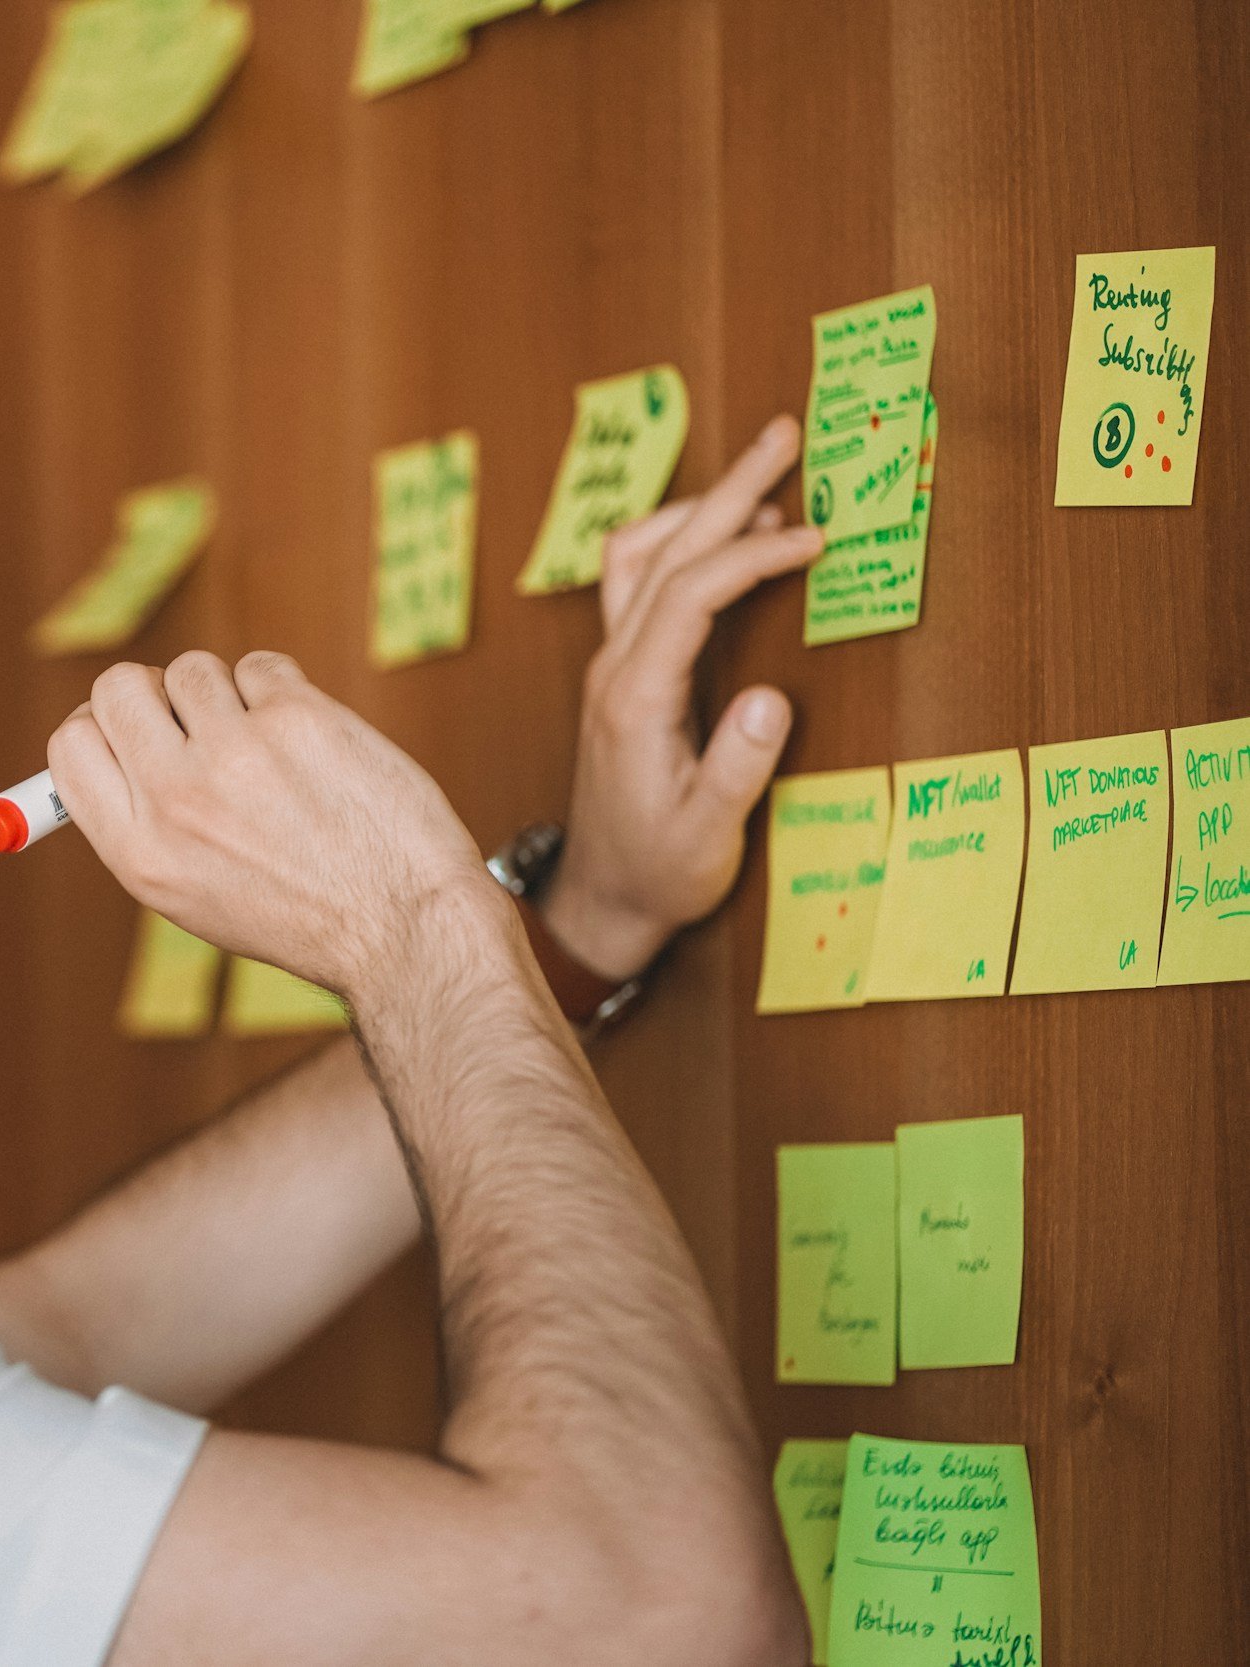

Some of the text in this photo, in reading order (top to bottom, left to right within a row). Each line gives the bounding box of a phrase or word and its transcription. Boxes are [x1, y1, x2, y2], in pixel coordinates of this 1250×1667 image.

[1088, 265, 1171, 331] Renting
[1044, 766, 1081, 808] NFT
[1053, 799, 1148, 852] MARKETPLACE
[1198, 802, 1233, 851] APP
[959, 1526, 1000, 1565] app
